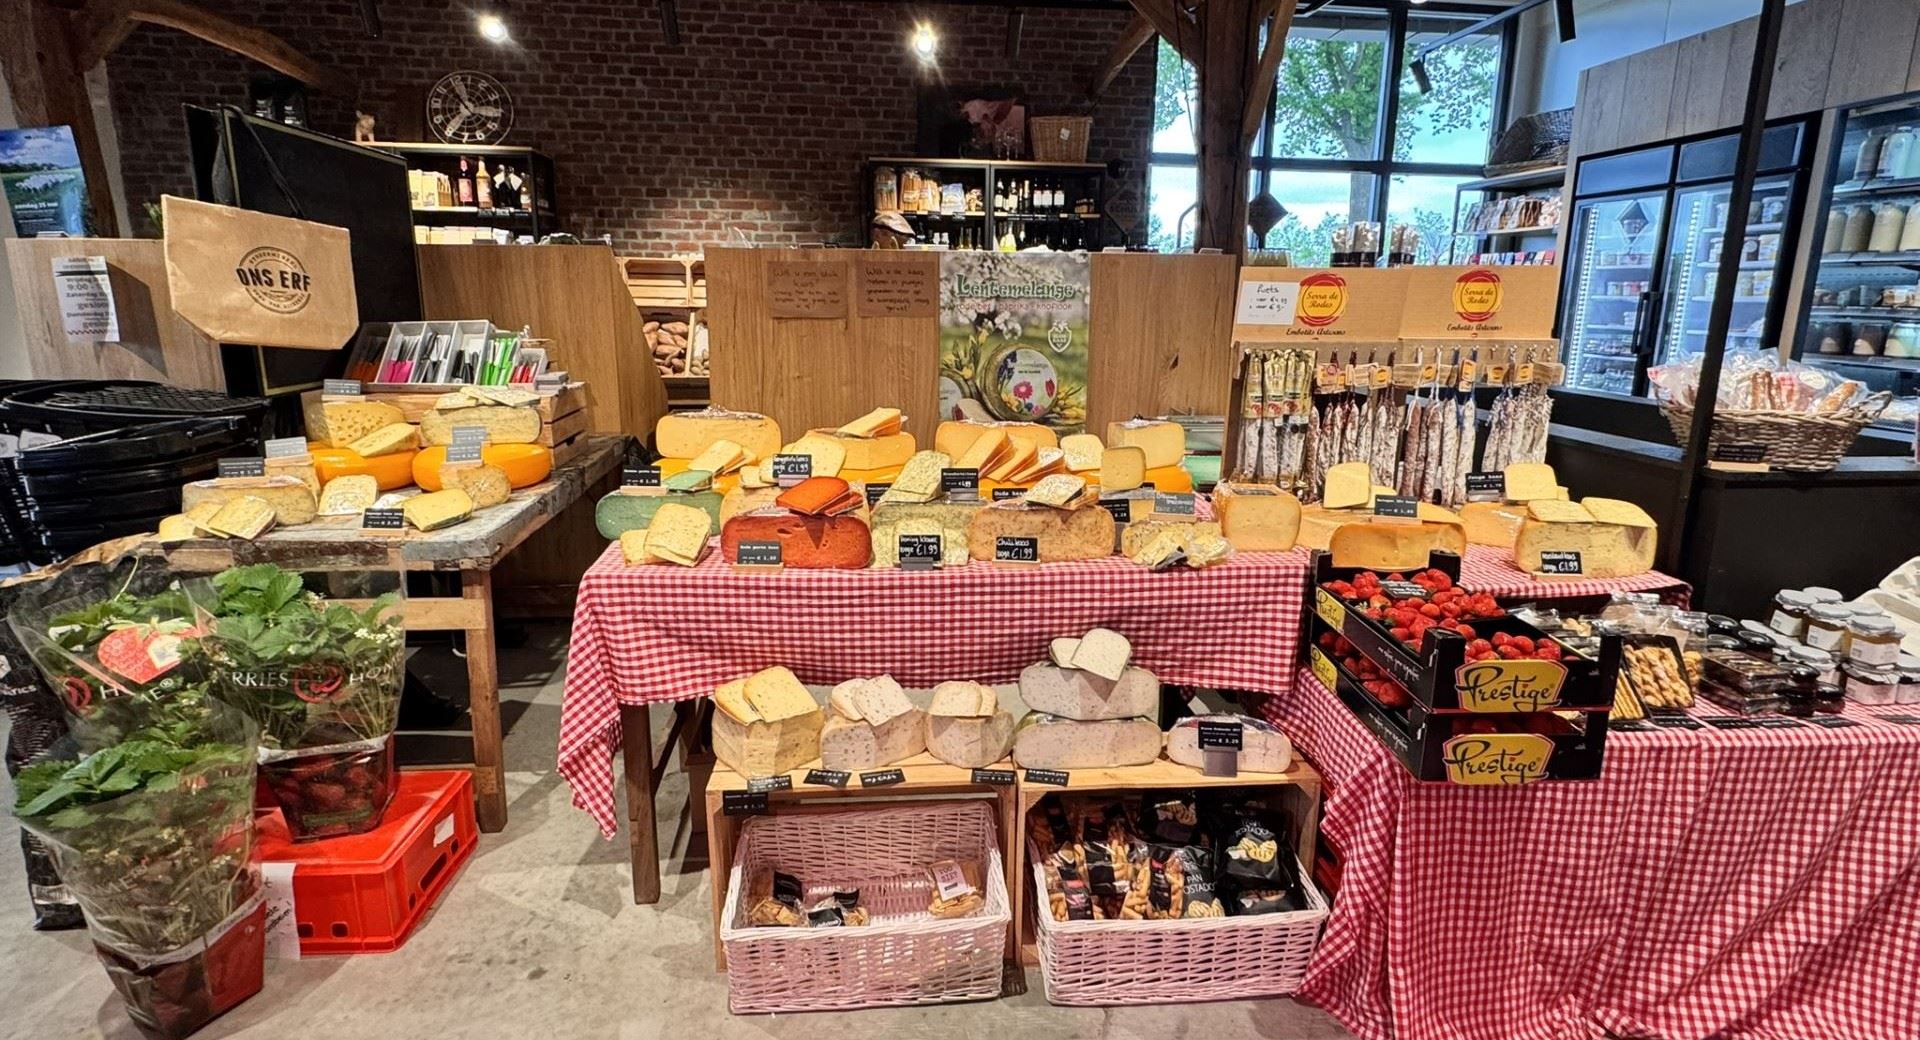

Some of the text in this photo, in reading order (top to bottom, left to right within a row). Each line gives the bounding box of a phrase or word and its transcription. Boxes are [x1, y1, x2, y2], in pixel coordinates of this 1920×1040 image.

[236, 267, 311, 293] ONS ERF
[956, 273, 1075, 300] Lentemelange
[1455, 665, 1561, 713] Prestige
[1442, 739, 1549, 785] Prestige
[1186, 873, 1203, 883] PAN
